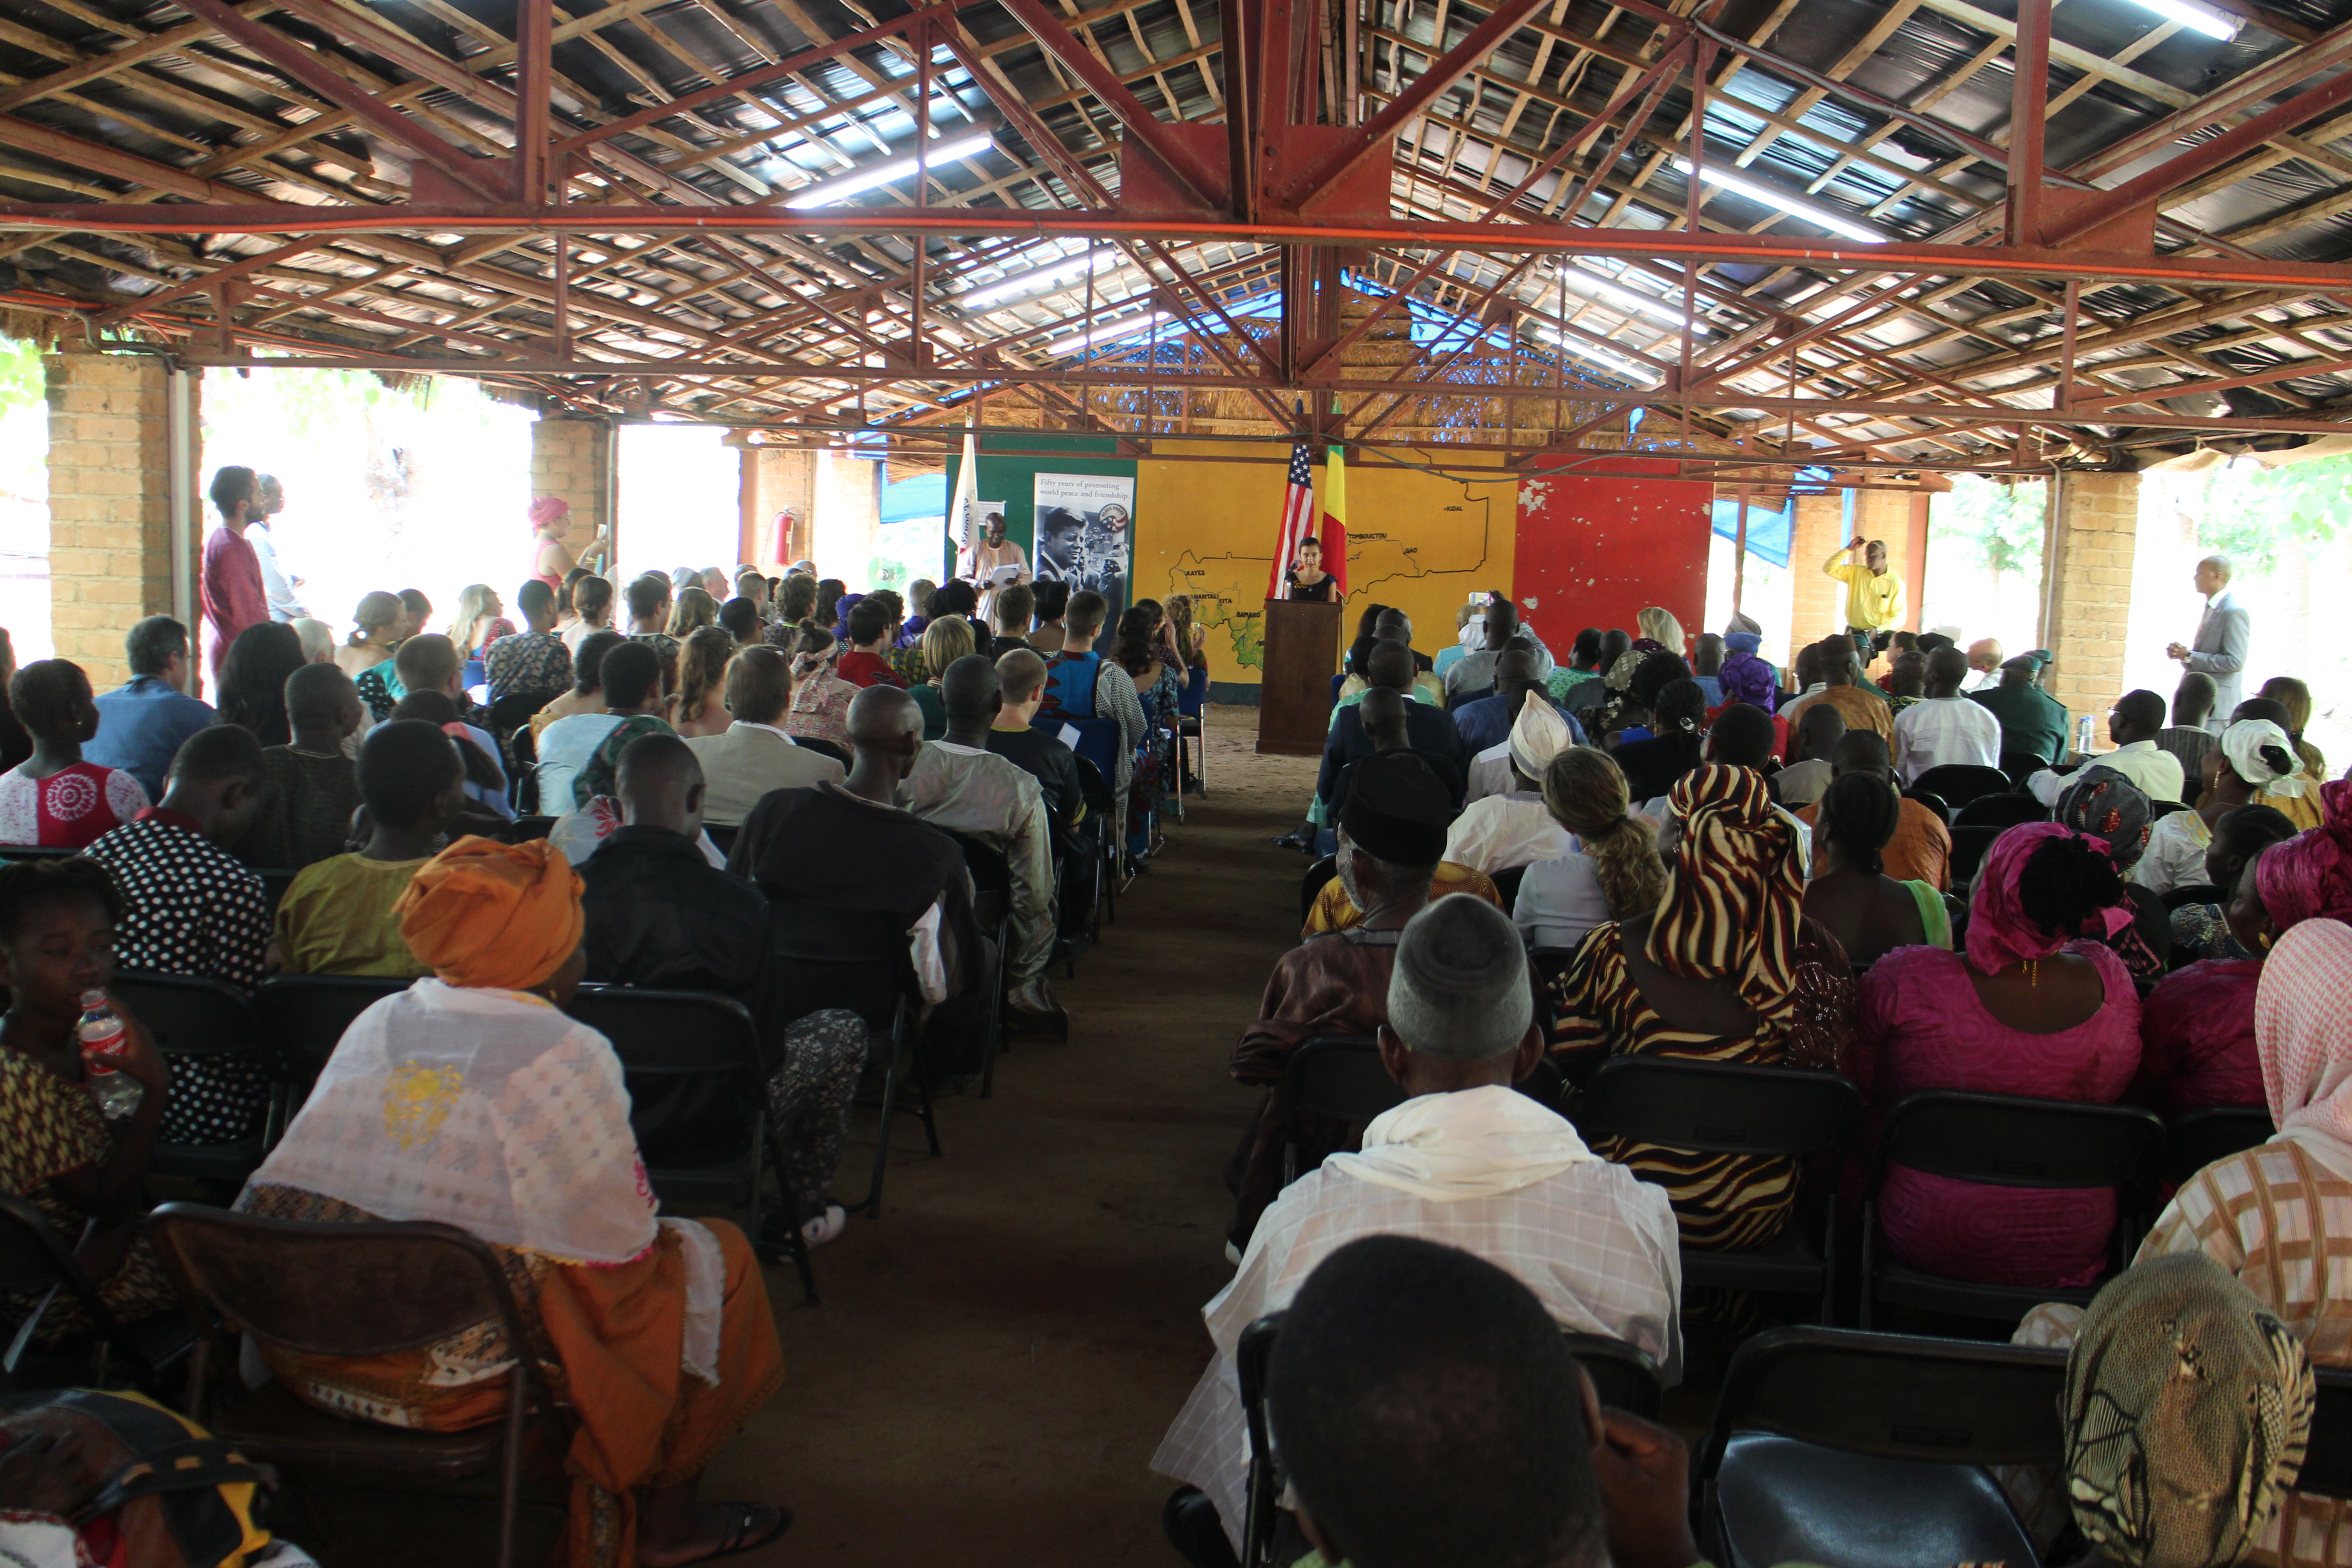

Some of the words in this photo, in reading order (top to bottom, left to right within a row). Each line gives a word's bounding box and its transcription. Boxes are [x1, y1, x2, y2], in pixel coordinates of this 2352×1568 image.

[1040, 479, 1055, 488] Fifty
[1095, 492, 1130, 500] friendship.
[1102, 506, 1112, 517] PEACE
[1112, 506, 1124, 515] CORPS
